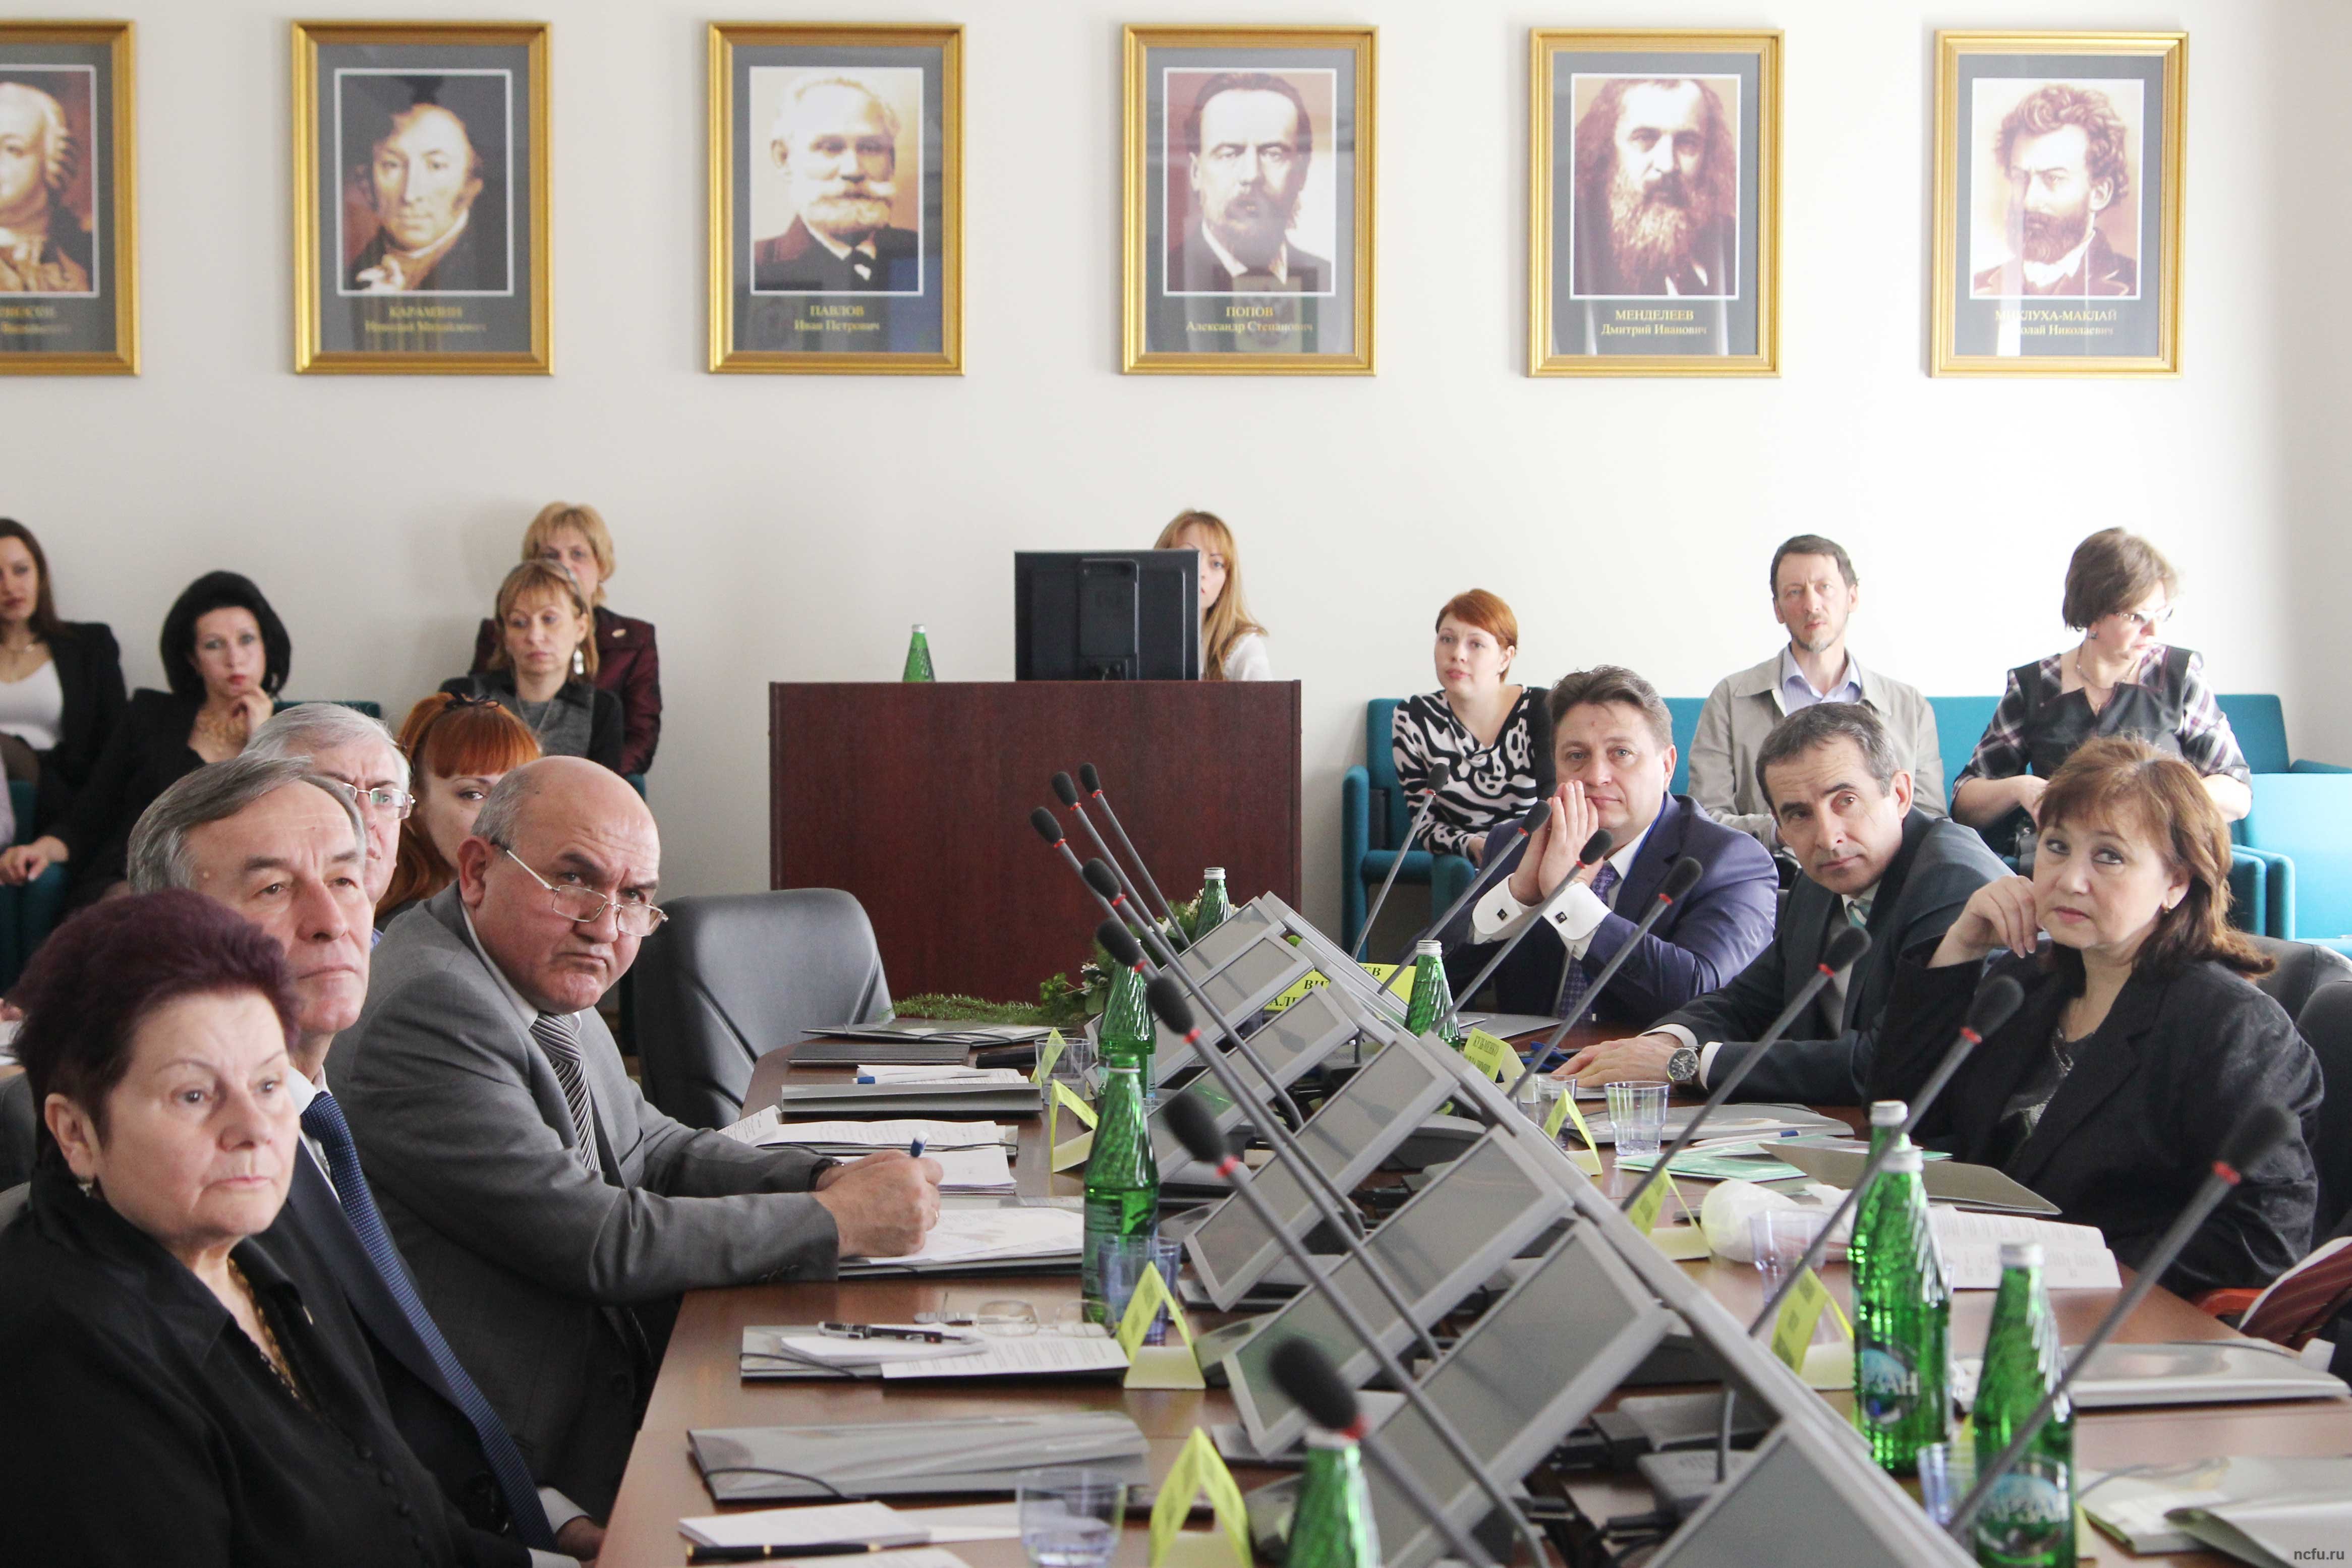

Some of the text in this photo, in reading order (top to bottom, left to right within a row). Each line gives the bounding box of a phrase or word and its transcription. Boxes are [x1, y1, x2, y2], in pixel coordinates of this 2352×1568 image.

[810, 306, 864, 316] ПАВЛОВ
[1226, 307, 1274, 317] ПОПОВ
[1616, 310, 1694, 321] МЕНДЕЛЕЕВ
[1186, 321, 1313, 334] Александр Степанович
[1601, 324, 1706, 337] Дмитрий Иванович
[2049, 324, 2113, 335] Николаевич
